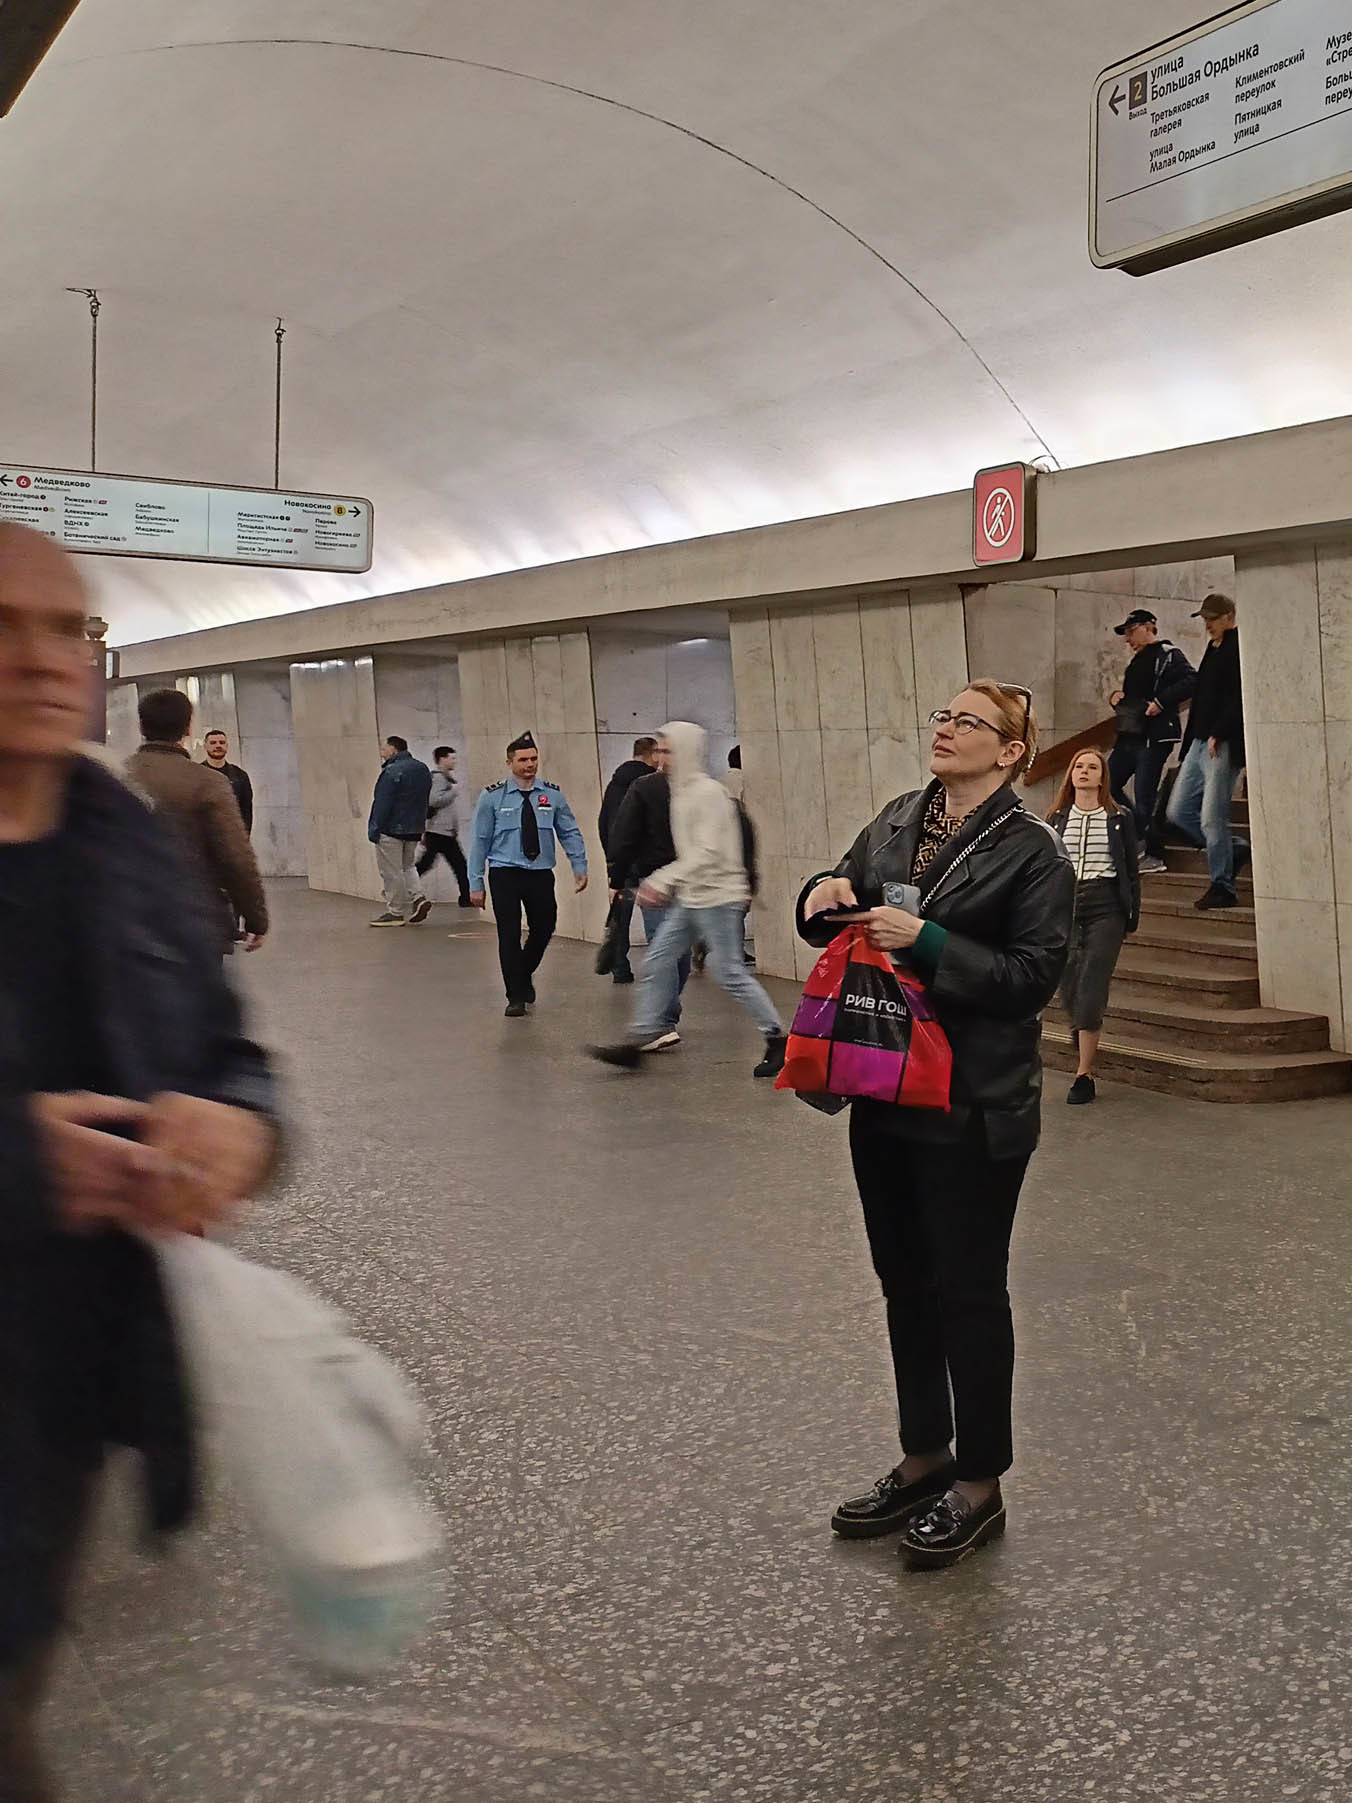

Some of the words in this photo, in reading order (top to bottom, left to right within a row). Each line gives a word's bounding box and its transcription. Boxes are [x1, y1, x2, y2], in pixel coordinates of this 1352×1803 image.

[1151, 56, 1184, 84] улица
[1151, 70, 1201, 101] Большая
[1203, 44, 1259, 78] Ордынка
[1235, 49, 1305, 88] Климентовский
[1134, 81, 1142, 101] 2
[1235, 79, 1276, 104] переулок
[1129, 107, 1147, 120] Выход
[1150, 92, 1210, 124] Третьяковская
[1235, 99, 1282, 125] Пятницкая
[1150, 117, 1182, 138] галерея
[1234, 123, 1260, 144] улица
[1150, 143, 1173, 161] улица
[1150, 156, 1176, 174] Малая
[1178, 140, 1216, 162] Ордынка
[33, 477, 91, 488] Медведково
[284, 499, 331, 510] Новокосино
[845, 993, 876, 1009] РИВ
[877, 999, 907, 1016] ГОШ
